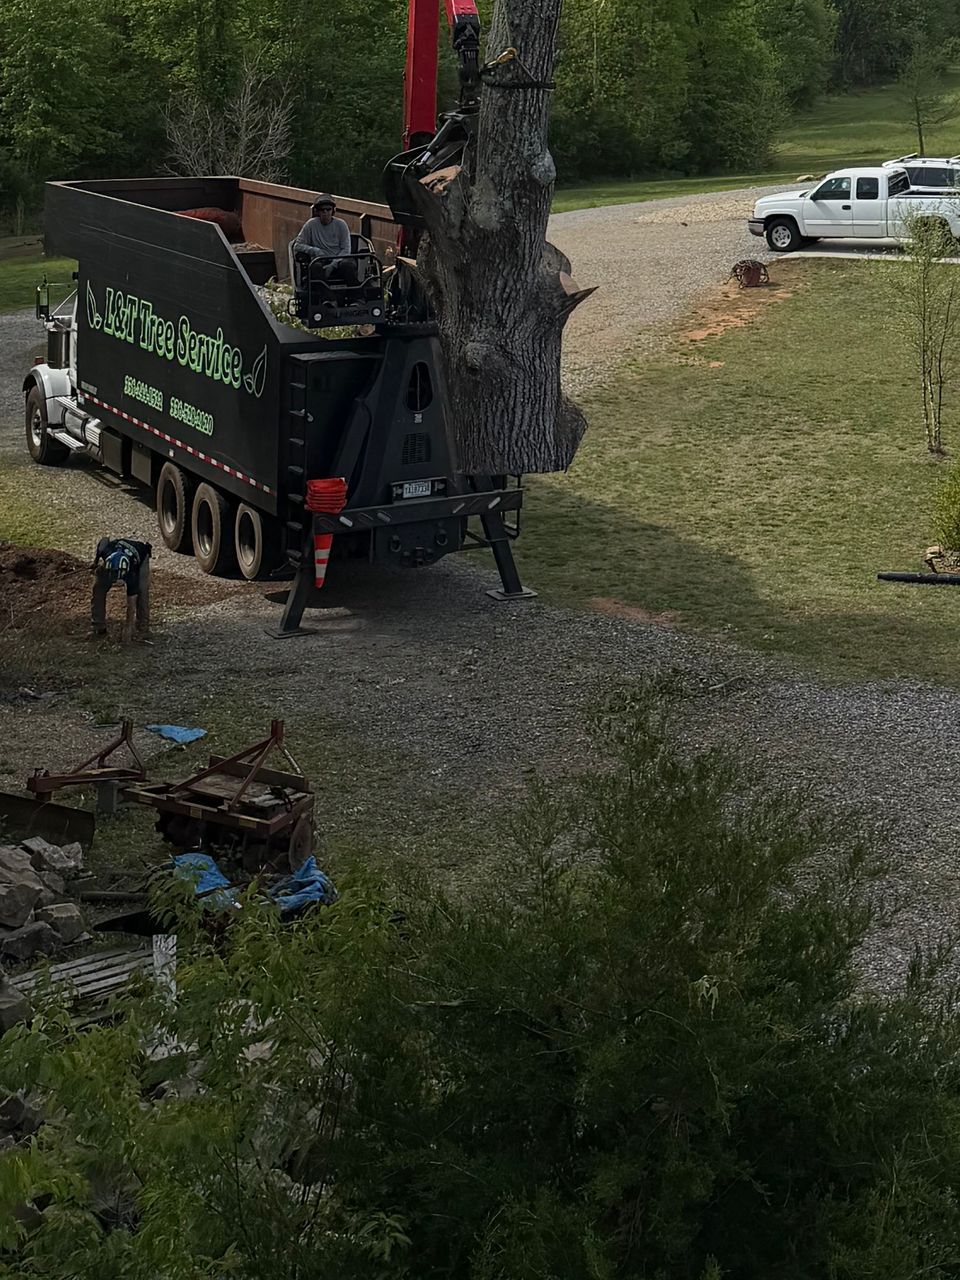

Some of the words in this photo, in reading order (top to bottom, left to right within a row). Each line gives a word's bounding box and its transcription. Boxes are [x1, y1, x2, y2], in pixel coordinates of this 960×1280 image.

[103, 287, 138, 344] L&T
[139, 299, 175, 361] Tree
[177, 315, 243, 389] Service
